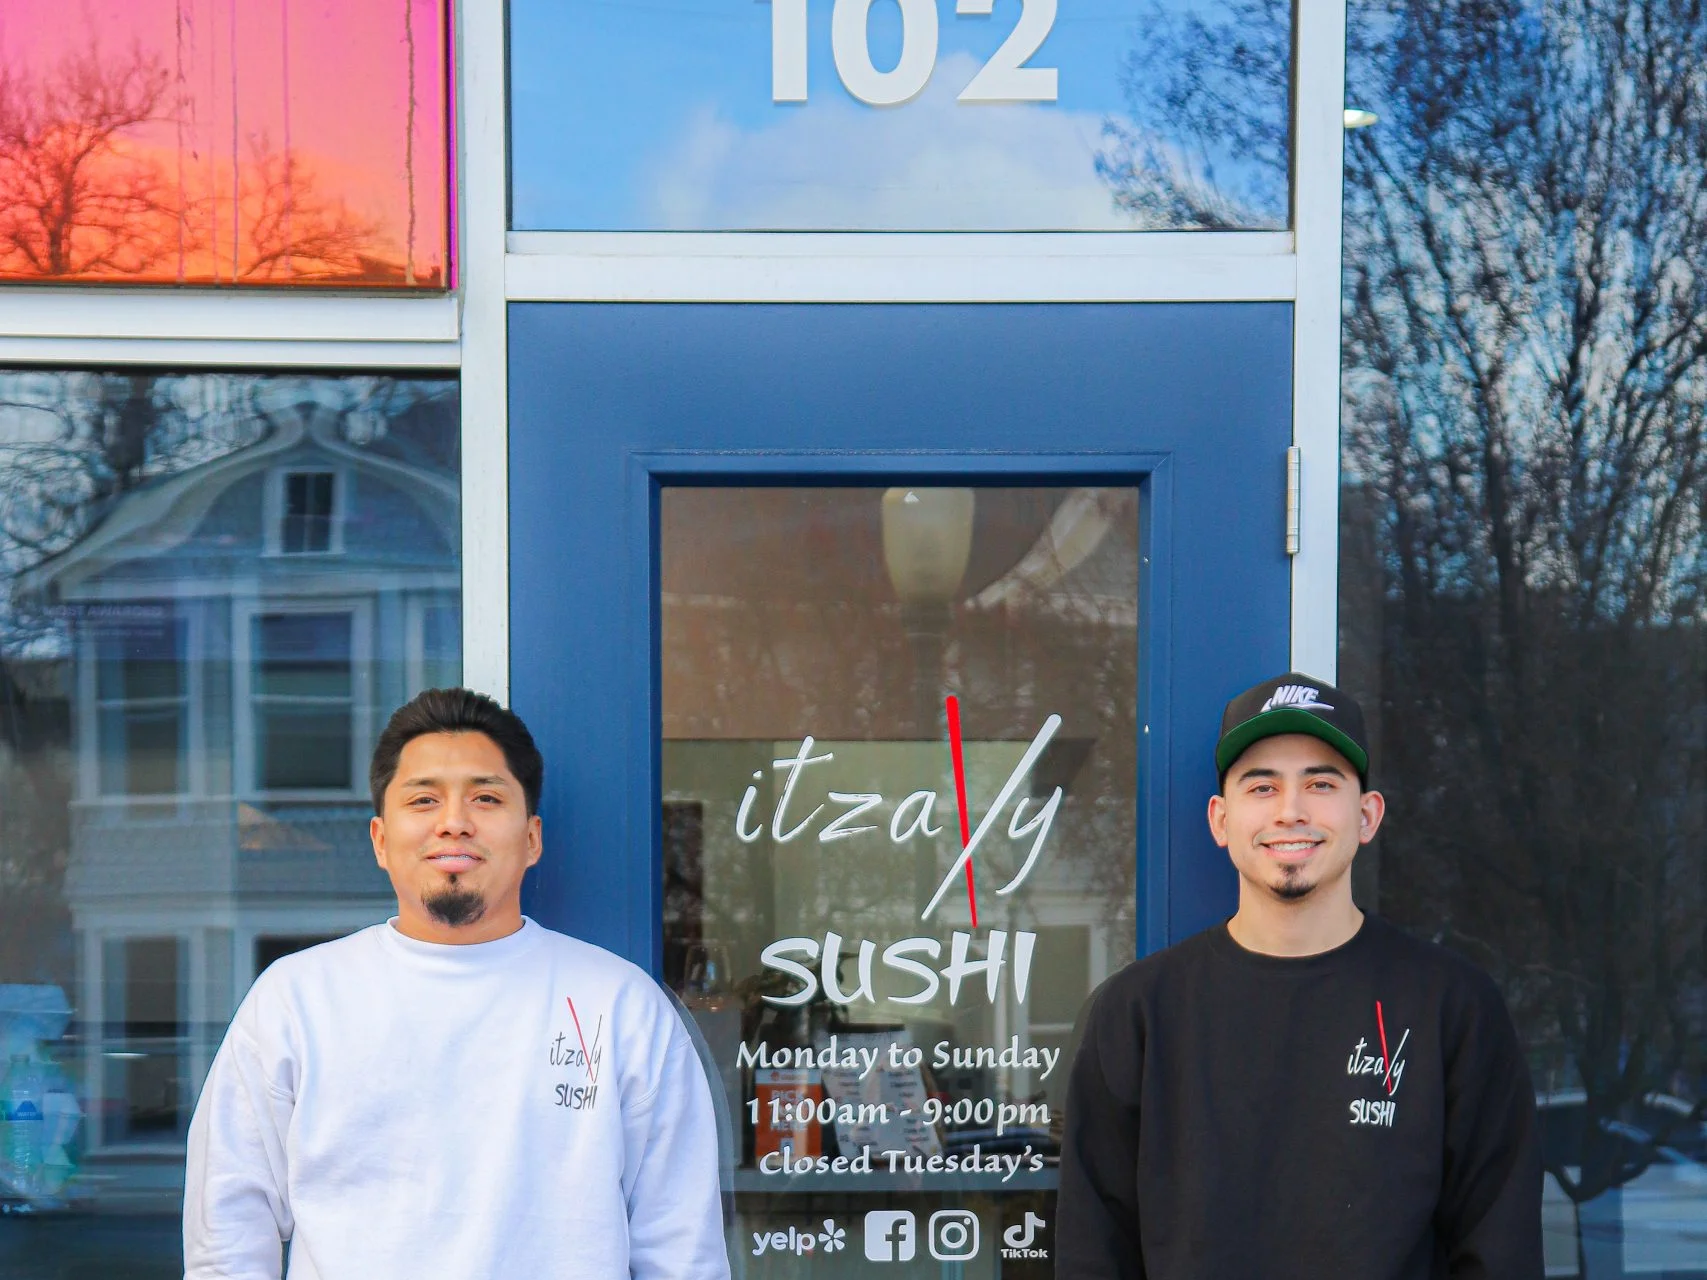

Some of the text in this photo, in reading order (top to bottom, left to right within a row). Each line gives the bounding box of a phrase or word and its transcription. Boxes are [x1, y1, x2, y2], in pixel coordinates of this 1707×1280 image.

[754, 0, 1059, 104] 102
[1271, 685, 1319, 706] NIKE
[760, 929, 1037, 1006] SUSHI
[736, 1034, 1061, 1080] Monday to Sunday
[555, 1082, 598, 1110] SUSHI
[1349, 1098, 1396, 1127] SUSHI
[746, 1097, 890, 1125] 11:00am
[922, 1097, 1052, 1138] 9:00pm
[759, 1143, 1045, 1182] Closed Tuesday's
[752, 1226, 816, 1256] yelp
[1000, 1248, 1048, 1259] TikTok
